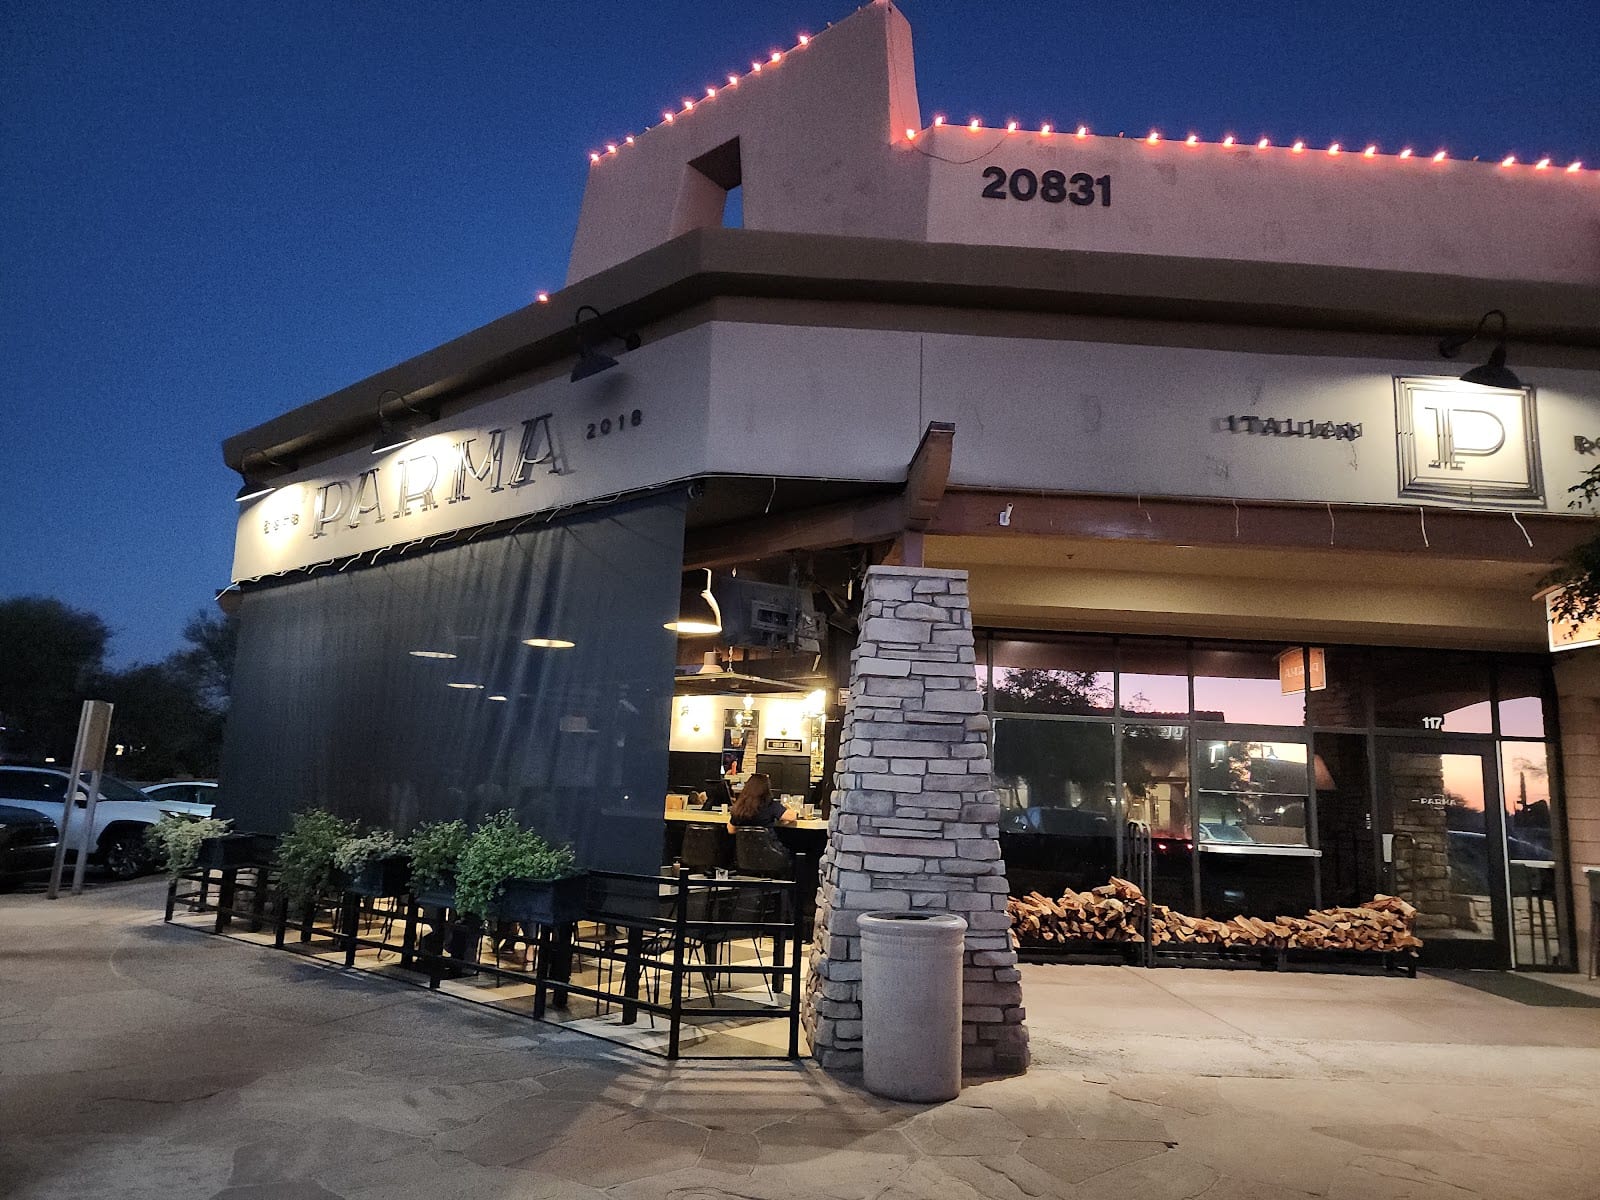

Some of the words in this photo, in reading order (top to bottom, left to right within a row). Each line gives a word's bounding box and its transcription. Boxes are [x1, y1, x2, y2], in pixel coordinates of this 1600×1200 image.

[982, 165, 1112, 207] 20831
[1228, 414, 1363, 441] ITALIAN
[309, 413, 561, 539] PARMA
[586, 409, 642, 440] 2018
[1421, 716, 1443, 730] 117
